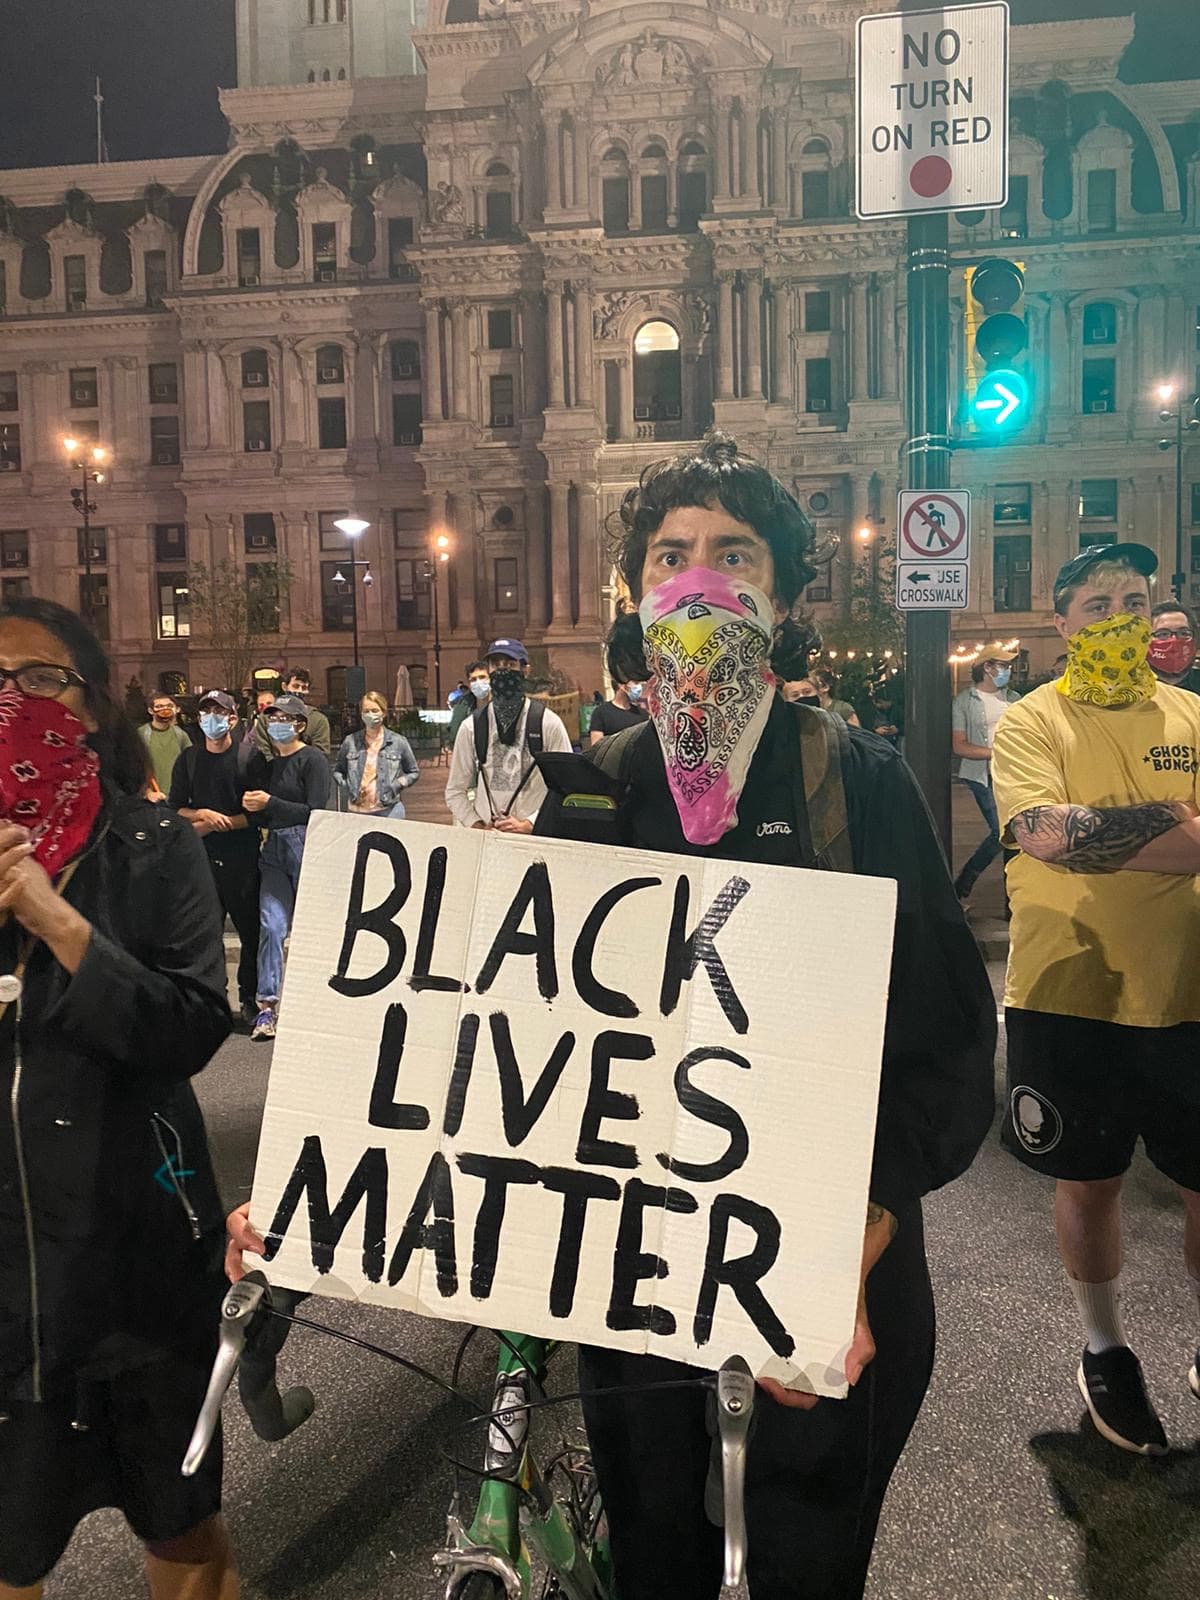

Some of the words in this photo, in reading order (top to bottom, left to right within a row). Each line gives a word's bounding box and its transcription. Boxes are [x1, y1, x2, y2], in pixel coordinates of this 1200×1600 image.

[903, 28, 961, 70] NO
[890, 77, 973, 110] TURN
[872, 123, 913, 153] ON
[930, 116, 992, 148] RED
[900, 588, 964, 602] CROSSWALK
[937, 570, 960, 584] USE
[756, 821, 792, 837] Vans
[328, 830, 751, 1034] BLACK
[368, 1002, 751, 1182] LIVES
[262, 1134, 796, 1358] MATTER
